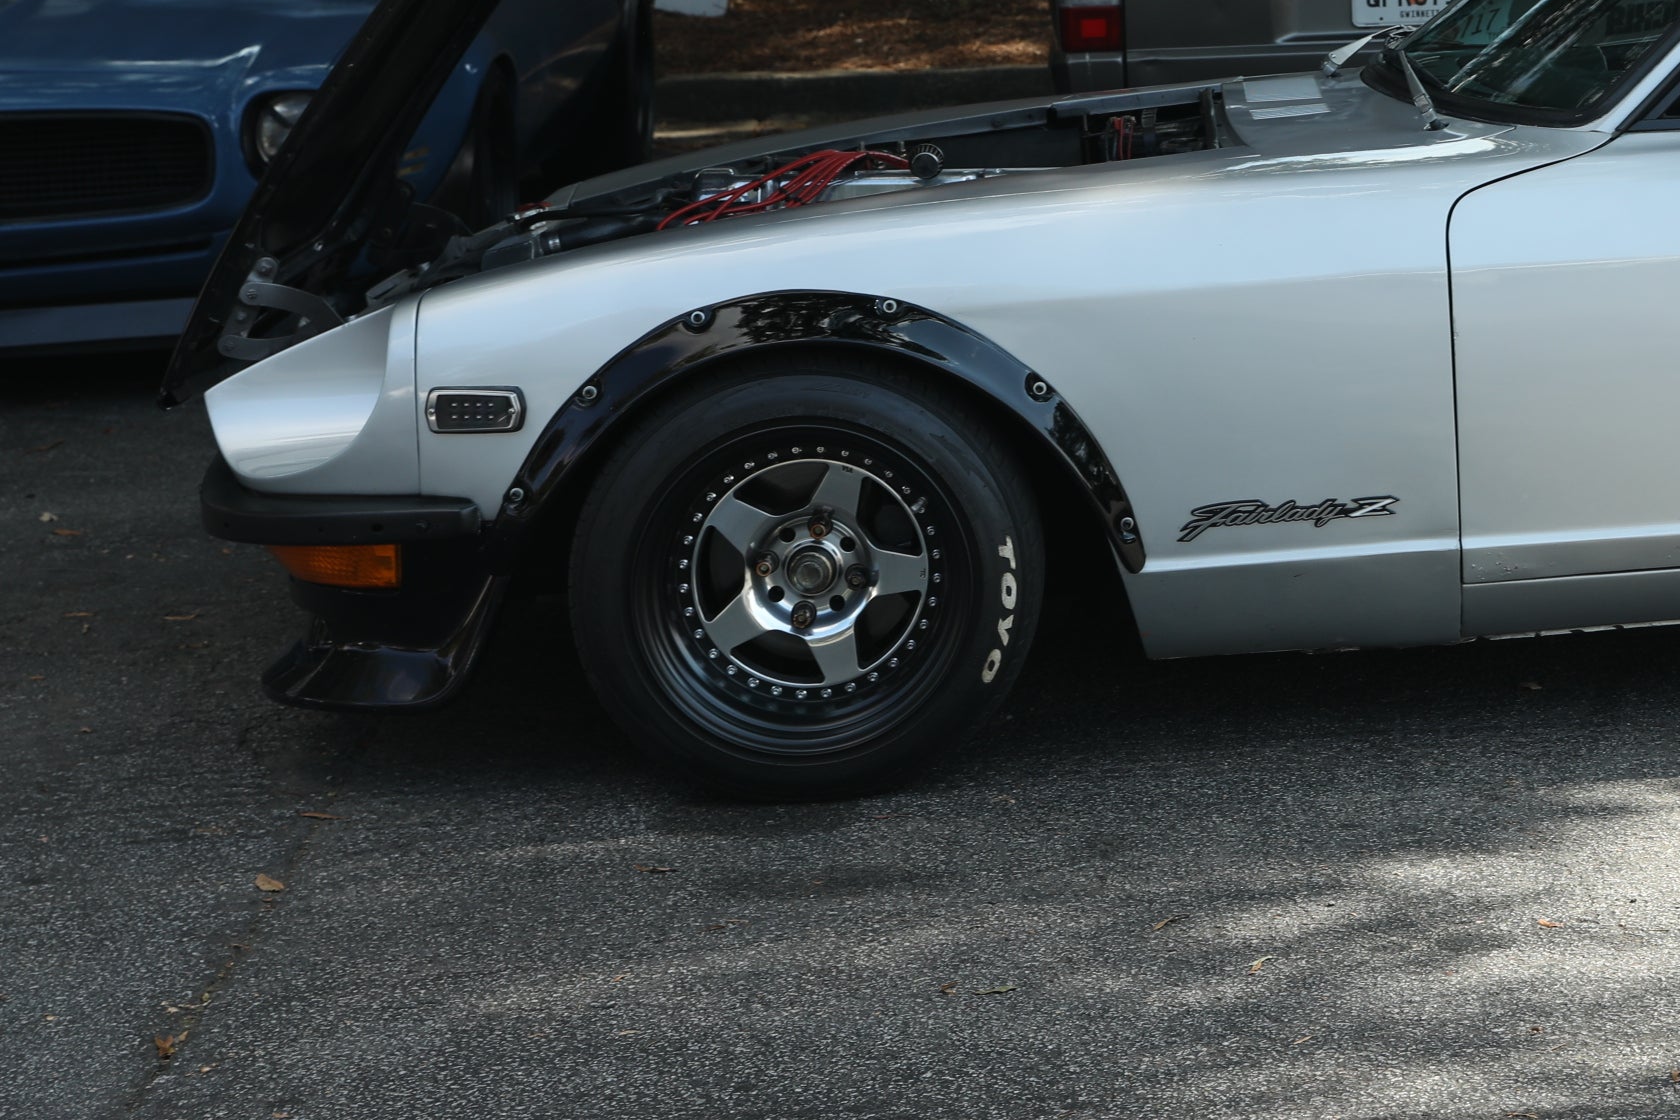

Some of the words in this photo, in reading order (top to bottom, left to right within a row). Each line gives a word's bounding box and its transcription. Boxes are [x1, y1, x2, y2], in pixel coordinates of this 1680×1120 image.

[1177, 498, 1348, 542] Fairlady
[1347, 495, 1400, 518] Z
[980, 535, 1020, 684] TOYO
